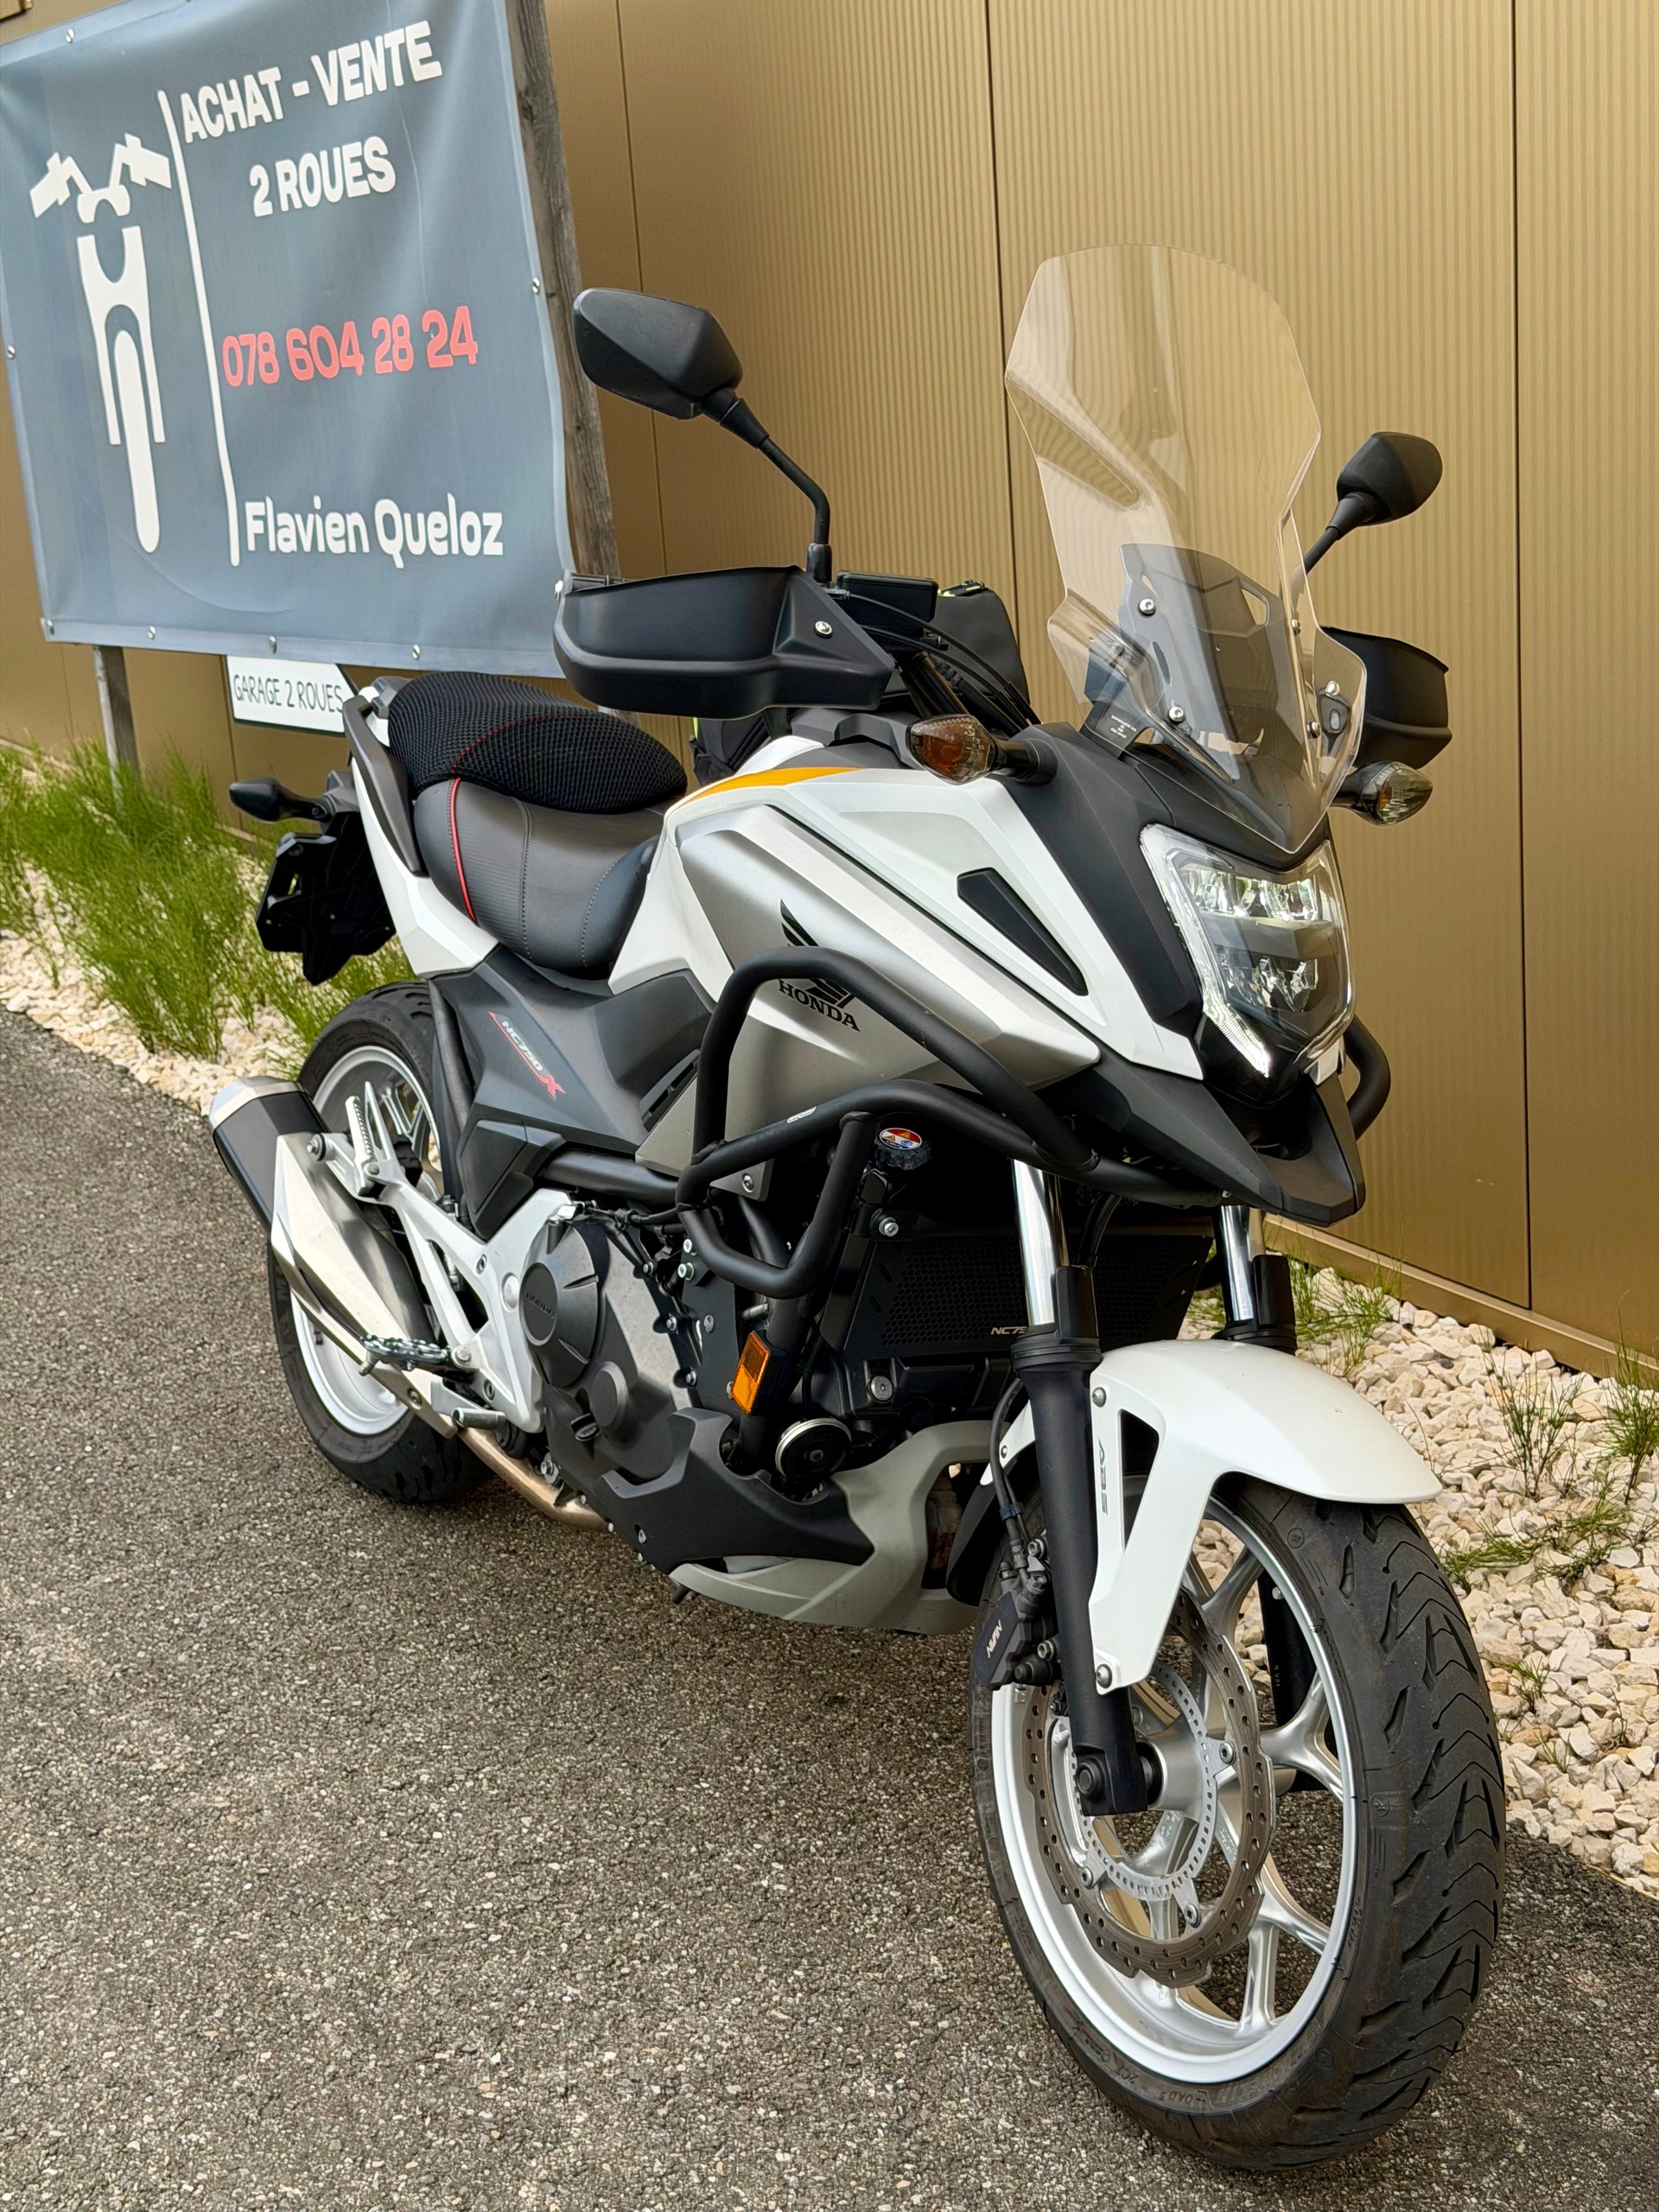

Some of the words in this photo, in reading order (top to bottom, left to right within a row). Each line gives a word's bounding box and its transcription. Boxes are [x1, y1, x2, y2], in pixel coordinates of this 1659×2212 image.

[181, 67, 283, 143] ACHAT
[292, 80, 310, 97] -
[310, 20, 442, 106] VENTE
[249, 164, 273, 218] 2
[275, 136, 396, 212] ROUES
[222, 331, 280, 387] 078
[285, 321, 364, 381] 604
[372, 315, 414, 374] 28
[422, 305, 479, 368] 24
[245, 495, 370, 554] Flavien
[373, 493, 504, 569] Queloz
[233, 674, 282, 707] GARAGE
[284, 679, 296, 708] 2
[296, 681, 344, 713] ROUES
[779, 978, 861, 1033] HONDA
[1098, 1438, 1108, 1516] ABS
